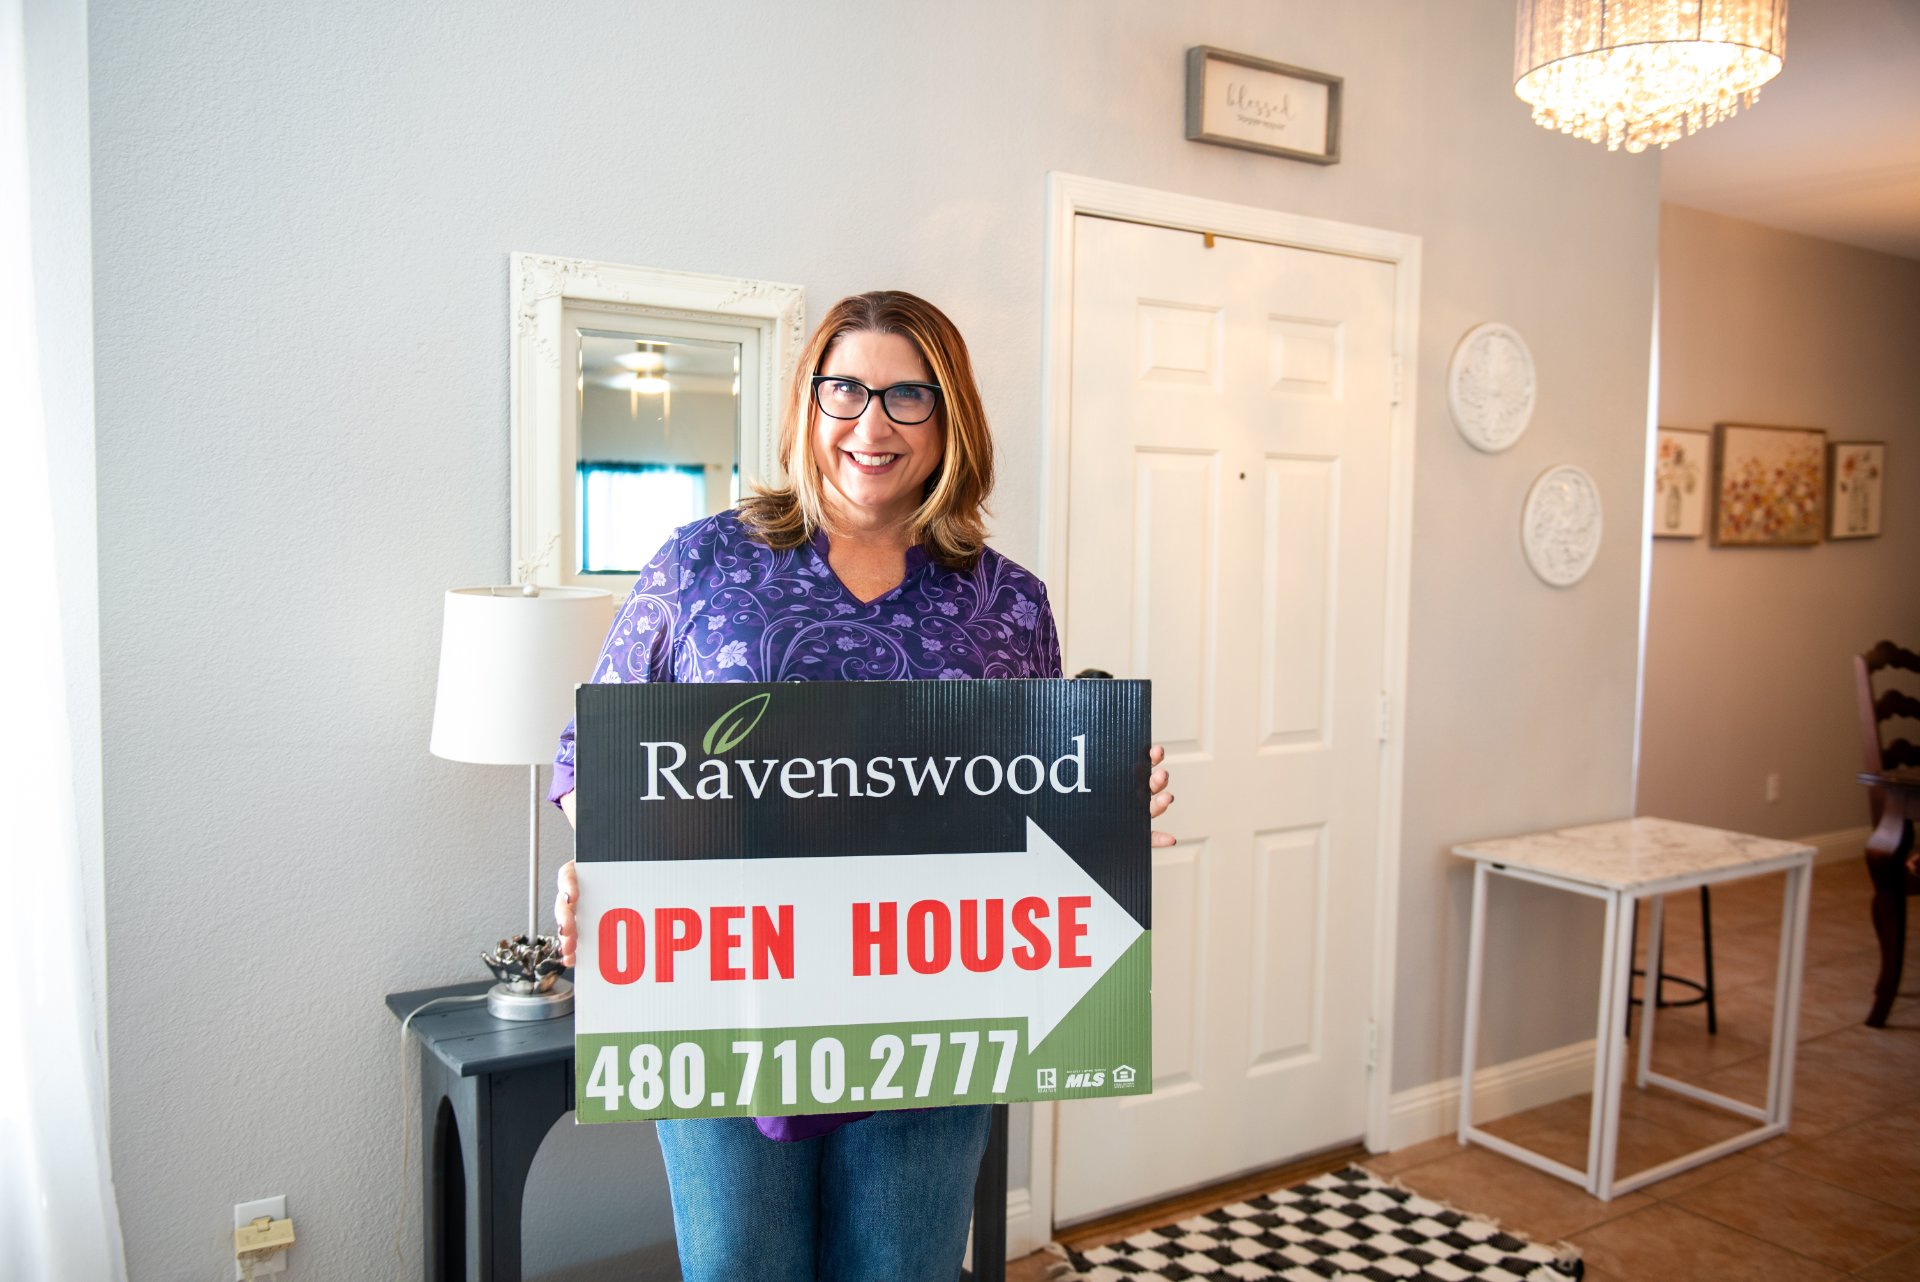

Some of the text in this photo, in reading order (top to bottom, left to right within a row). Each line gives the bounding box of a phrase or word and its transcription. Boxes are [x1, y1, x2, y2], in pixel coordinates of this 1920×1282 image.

[639, 734, 1092, 801] Ravenswood
[598, 896, 1092, 985] OPEN HOUSE
[585, 1030, 1018, 1111] 480.710.2777
[1065, 1072, 1105, 1088] MLS
